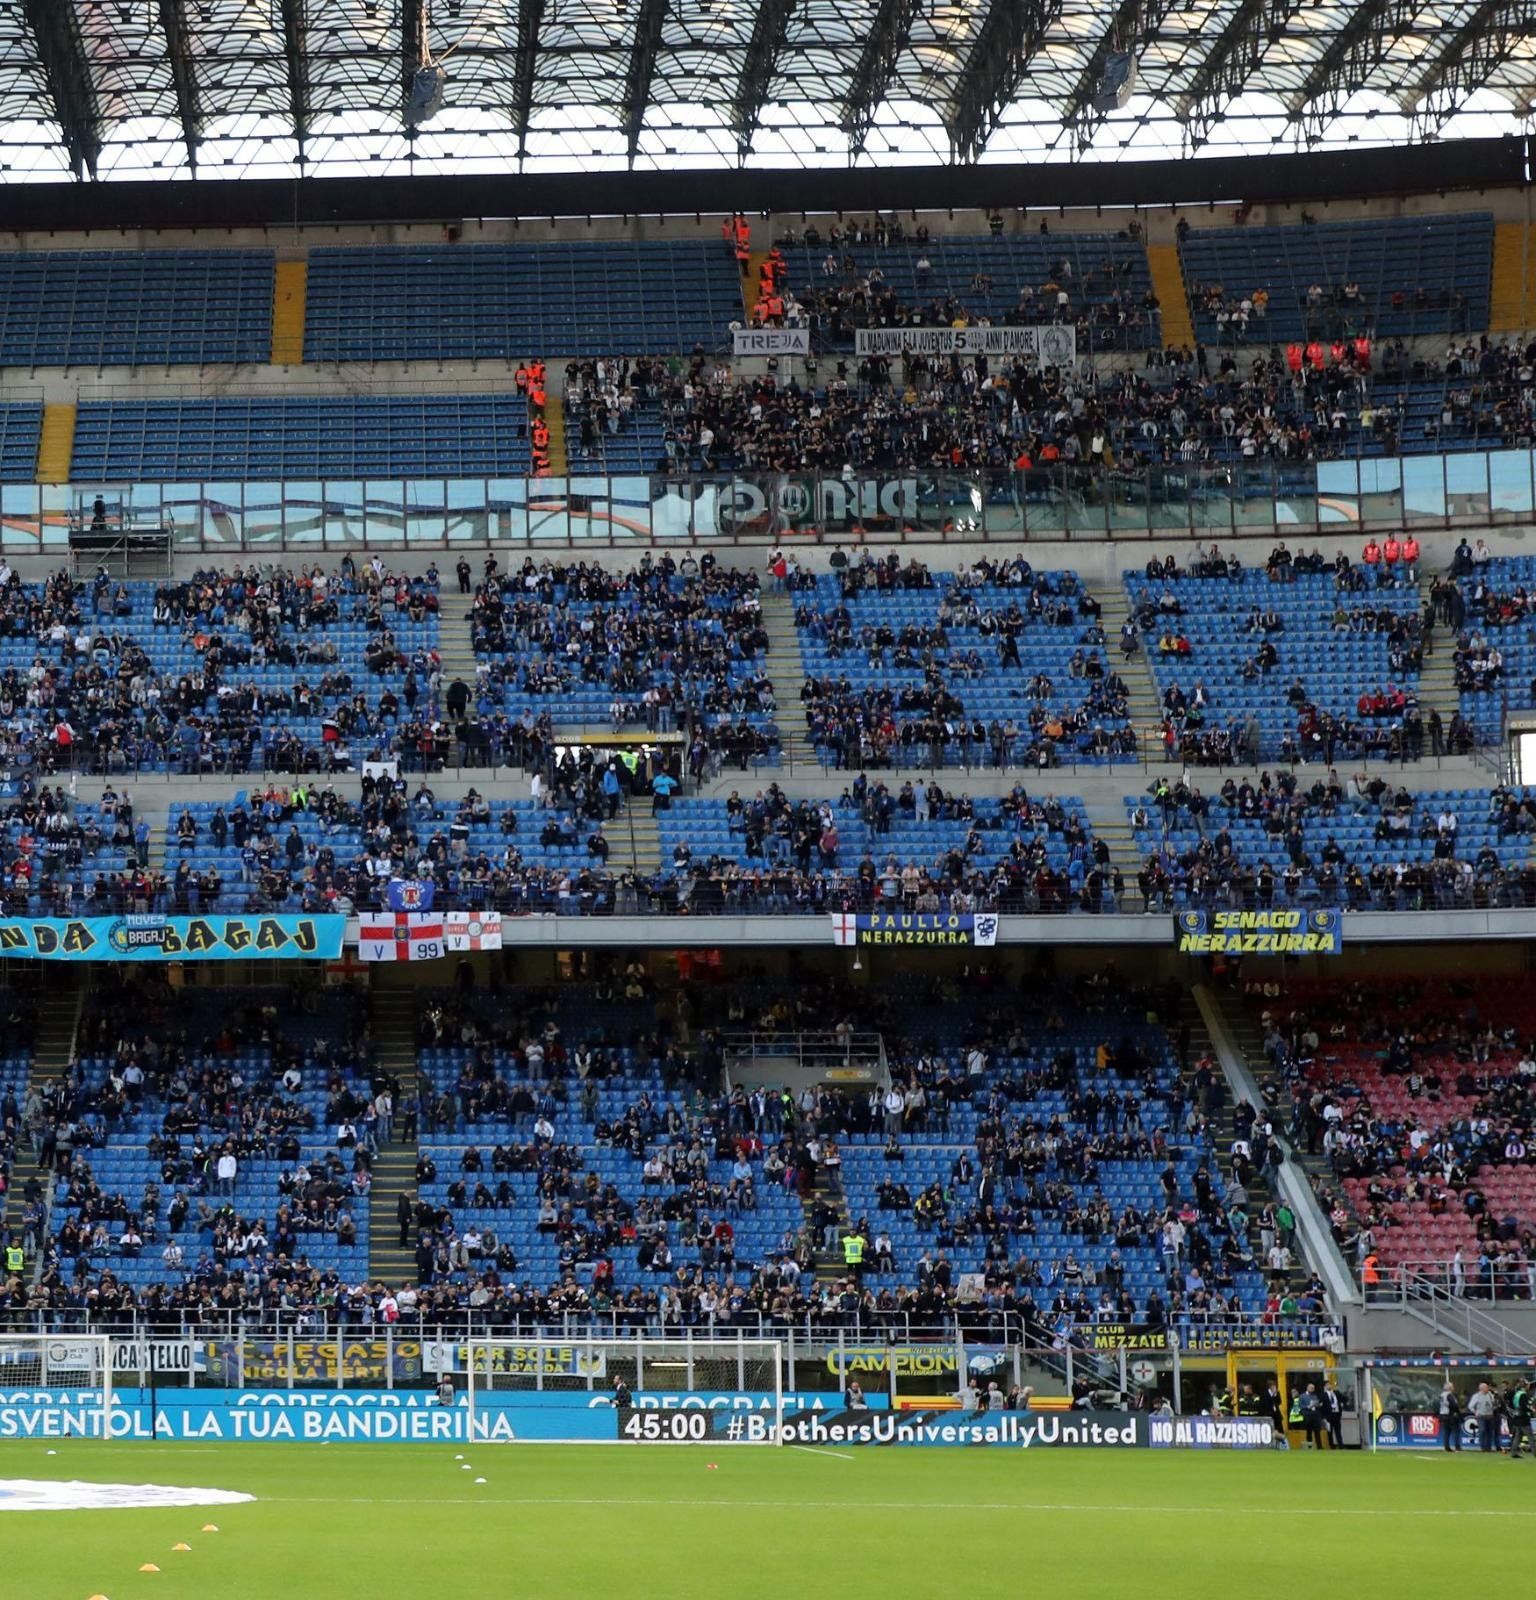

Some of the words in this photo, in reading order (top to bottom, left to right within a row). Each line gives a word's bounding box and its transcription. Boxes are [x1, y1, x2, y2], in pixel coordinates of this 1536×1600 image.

[954, 332, 966, 348] 5
[870, 915, 960, 927] PAULLO
[1214, 912, 1301, 928] SENAGO
[128, 930, 166, 944] BAGAJ
[161, 919, 317, 954] BAGAJ
[862, 931, 968, 943] NERAZZURRA
[1179, 933, 1335, 952] NERAZZURRA
[1097, 1326, 1125, 1334] CLUB
[1094, 1334, 1166, 1349] MEZZATE
[273, 1343, 421, 1359] PEGASO
[513, 1347, 573, 1362] SOLE
[0, 1408, 175, 1437] SVENTOLA
[183, 1409, 223, 1437] LA
[229, 1409, 295, 1438] TUA
[304, 1409, 515, 1438] BANDIERINA
[625, 1413, 707, 1440] 45:00
[726, 1412, 1137, 1448] #BrothersUniversallyUnited
[1412, 1415, 1435, 1432] RDS
[1152, 1422, 1173, 1443] NO
[1175, 1422, 1194, 1443] AL
[1196, 1422, 1272, 1444] RAZZISMO
